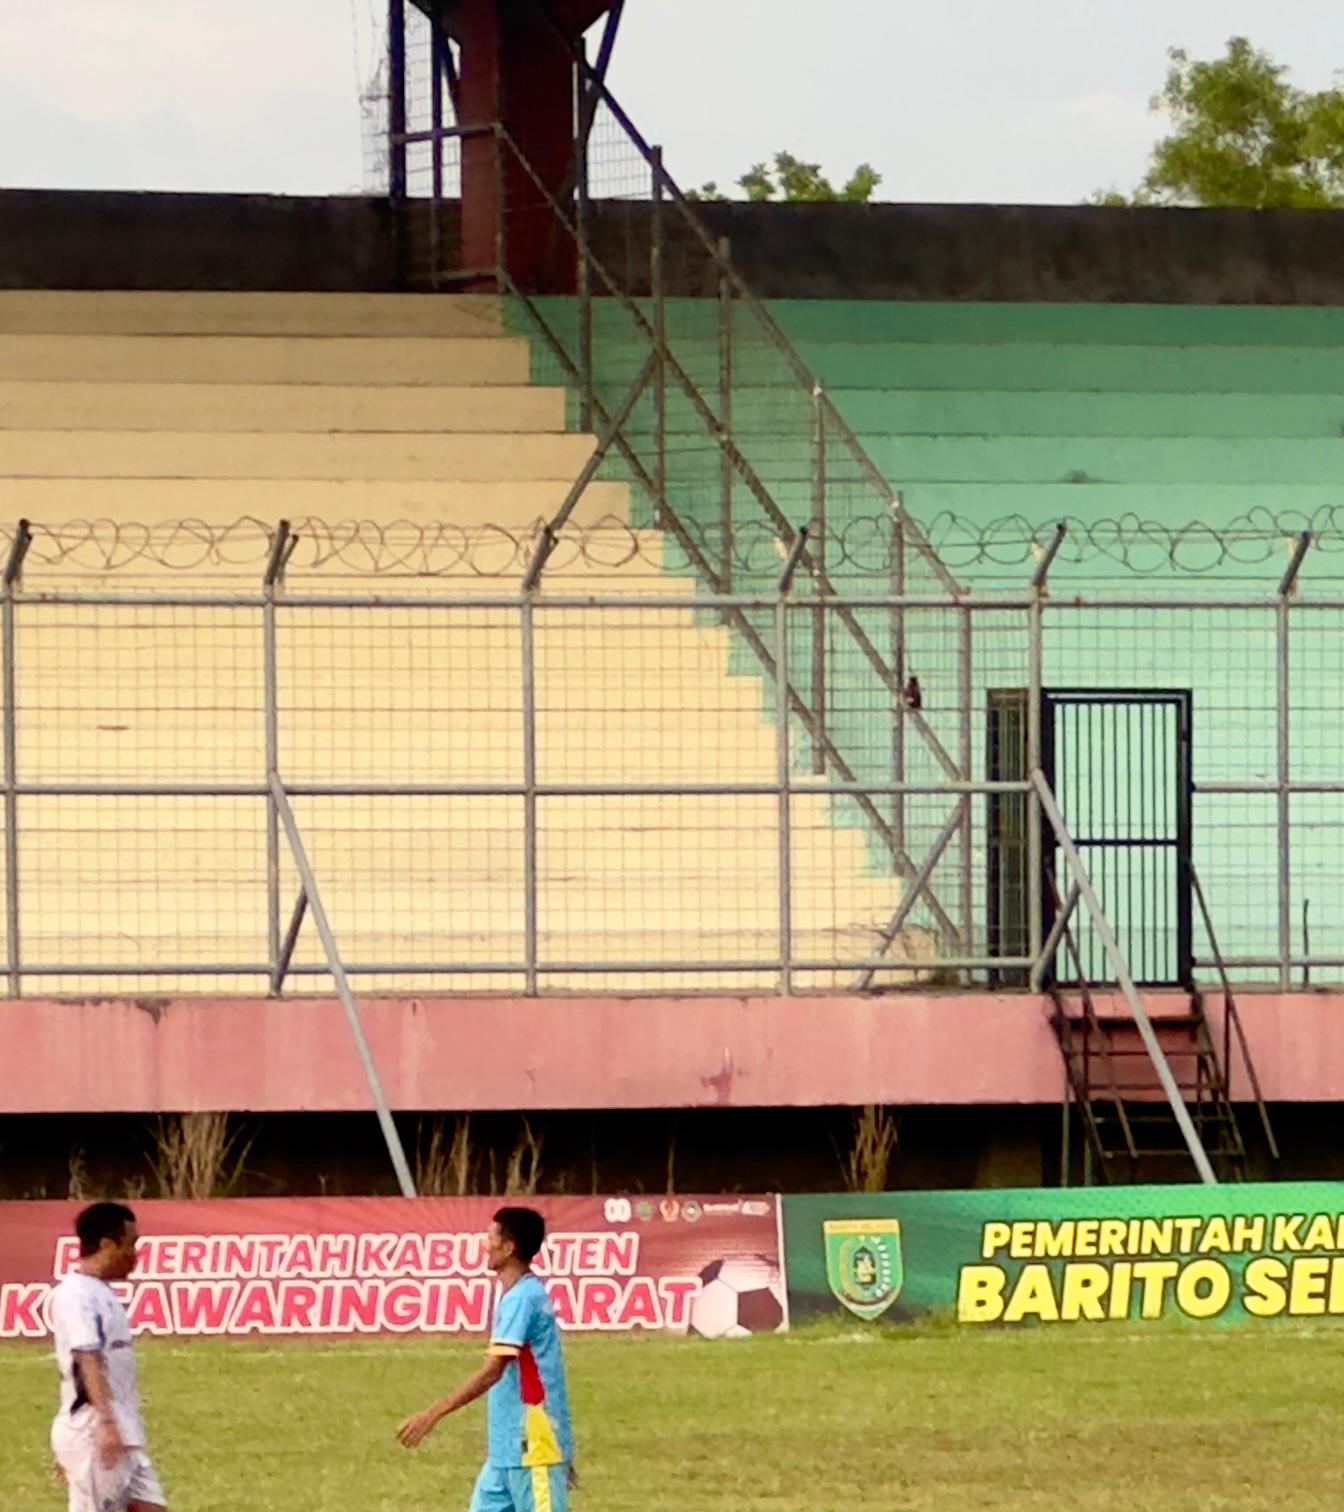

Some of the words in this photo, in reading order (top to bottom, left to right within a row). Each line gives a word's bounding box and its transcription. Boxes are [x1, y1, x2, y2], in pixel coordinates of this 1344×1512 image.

[980, 1215, 1265, 1259] PEMERINTAH
[545, 1281, 698, 1327] ARAT
[957, 1258, 1232, 1323] BARITO
